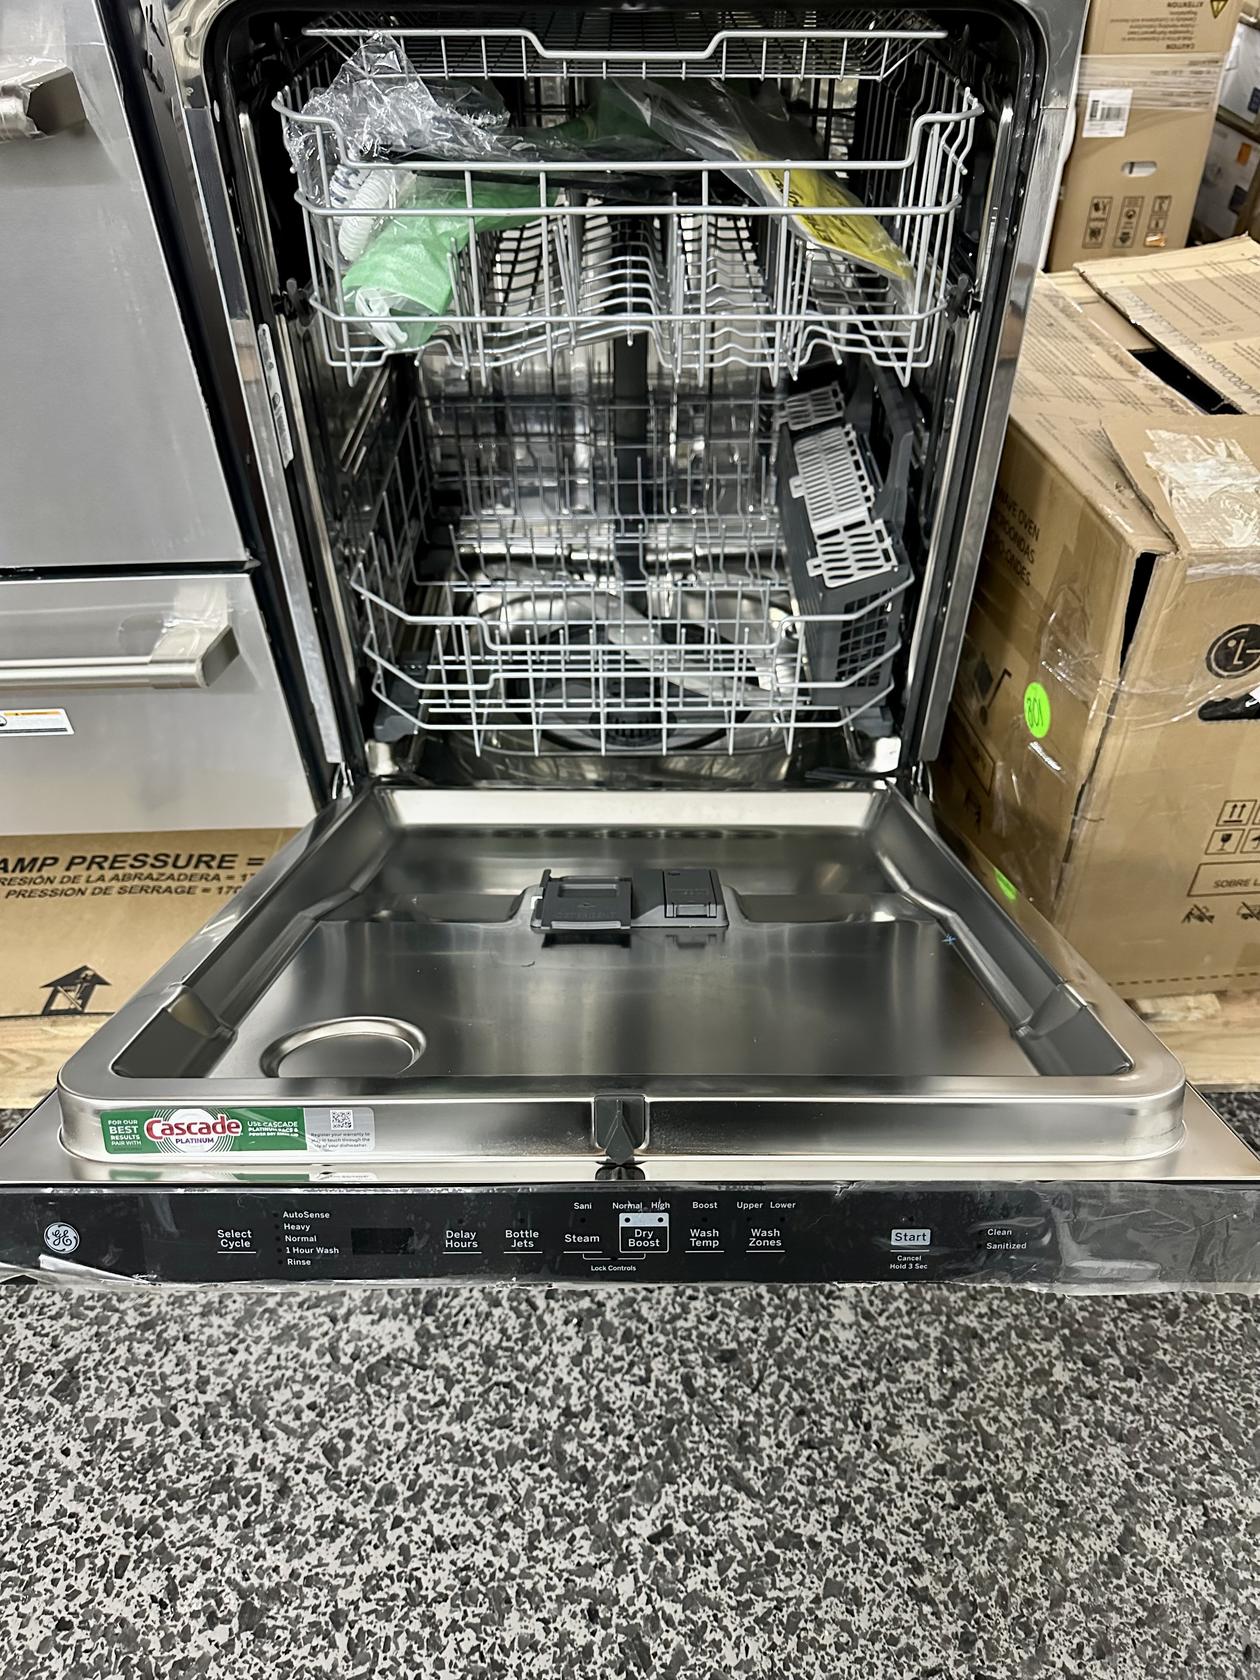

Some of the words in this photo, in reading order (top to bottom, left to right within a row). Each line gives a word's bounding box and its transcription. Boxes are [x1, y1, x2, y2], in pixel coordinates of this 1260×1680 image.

[1017, 507, 1040, 542] OVEN
[65, 853, 239, 871] PRESSURE
[60, 874, 82, 885] DE
[85, 874, 106, 884] LA
[107, 872, 221, 882] ABRAZADERA
[5, 887, 88, 899] PRESSION
[91, 885, 115, 896] DE
[118, 884, 199, 895] SERRAGE
[109, 1125, 139, 1134] BEST
[145, 1115, 241, 1140] Cascade
[573, 1202, 592, 1210] Sani
[612, 1201, 642, 1209] Normal
[651, 1201, 670, 1211] High
[692, 1201, 718, 1209] Boost
[736, 1201, 763, 1210] Upper
[770, 1201, 796, 1209] Lower
[282, 1211, 330, 1219] AutoSense
[283, 1223, 310, 1232] Heavy
[987, 1228, 1012, 1236] Clean
[217, 1229, 252, 1239] Select
[445, 1230, 477, 1240] Delay
[505, 1229, 540, 1238] Bottle
[634, 1229, 653, 1239] Dry
[690, 1228, 719, 1237] Wash
[751, 1228, 780, 1237] Wash
[895, 1232, 927, 1242] Start
[284, 1234, 317, 1242] Normal
[564, 1233, 600, 1243] Steam
[628, 1238, 660, 1247] Boost
[749, 1238, 782, 1247] Zones
[220, 1239, 251, 1249] Cycle
[445, 1239, 478, 1248] Hours
[511, 1239, 534, 1248] Jets
[690, 1238, 719, 1248] Temp
[986, 1242, 1027, 1250] Sanitized
[287, 1258, 311, 1266] Rinse
[607, 1264, 637, 1272] Controls
